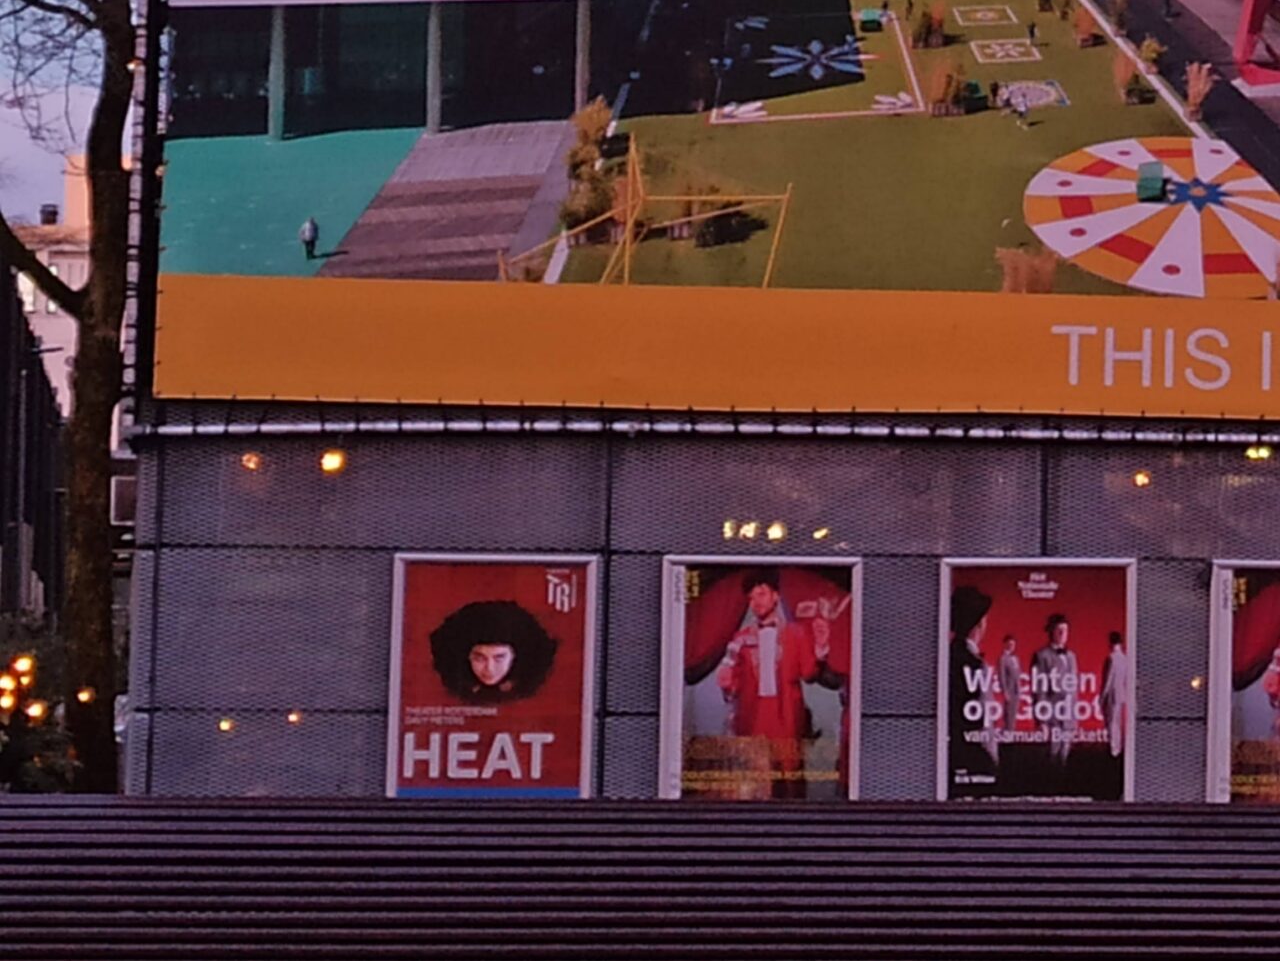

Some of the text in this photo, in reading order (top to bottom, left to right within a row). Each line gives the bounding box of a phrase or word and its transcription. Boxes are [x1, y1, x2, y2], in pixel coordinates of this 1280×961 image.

[1050, 324, 1231, 391] THIS
[963, 664, 1097, 694] Wachten
[963, 694, 1104, 728] op Godot
[963, 726, 1109, 743] van Samuel Beckett
[403, 732, 555, 780] HEAT
